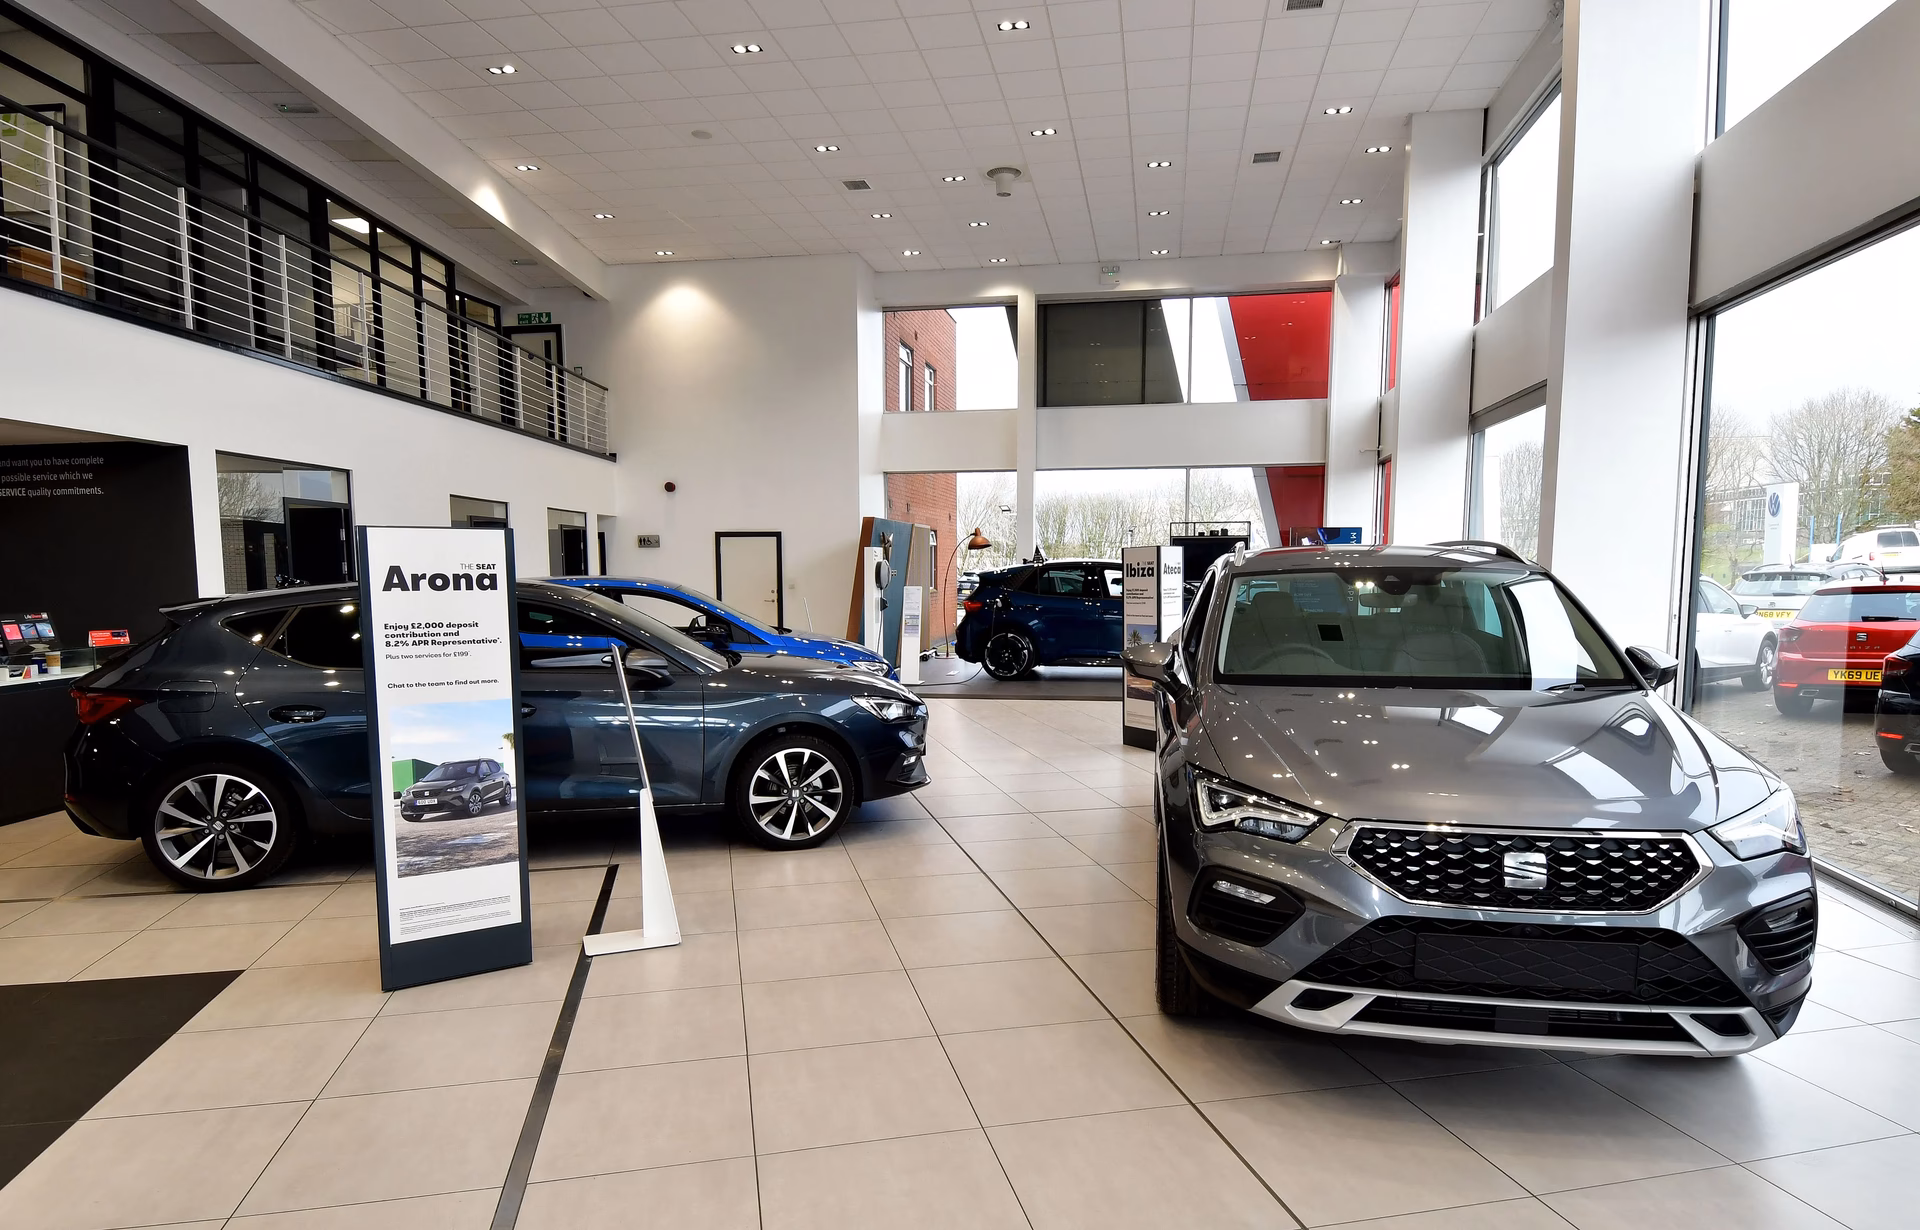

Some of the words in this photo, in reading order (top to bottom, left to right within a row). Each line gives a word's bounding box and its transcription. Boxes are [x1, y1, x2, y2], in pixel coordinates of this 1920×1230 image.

[29, 460, 42, 468] you
[52, 457, 69, 465] have
[71, 456, 104, 466] complete
[1, 473, 30, 483] possible
[32, 472, 57, 481] service
[59, 471, 81, 480] which
[27, 487, 51, 498] quality
[53, 487, 104, 495] commitments.
[1126, 562, 1154, 577] Ibiza
[1163, 563, 1181, 574] Ateca
[382, 566, 498, 591] Arona
[446, 621, 479, 629] deposit
[1833, 670, 1862, 680] YK69
